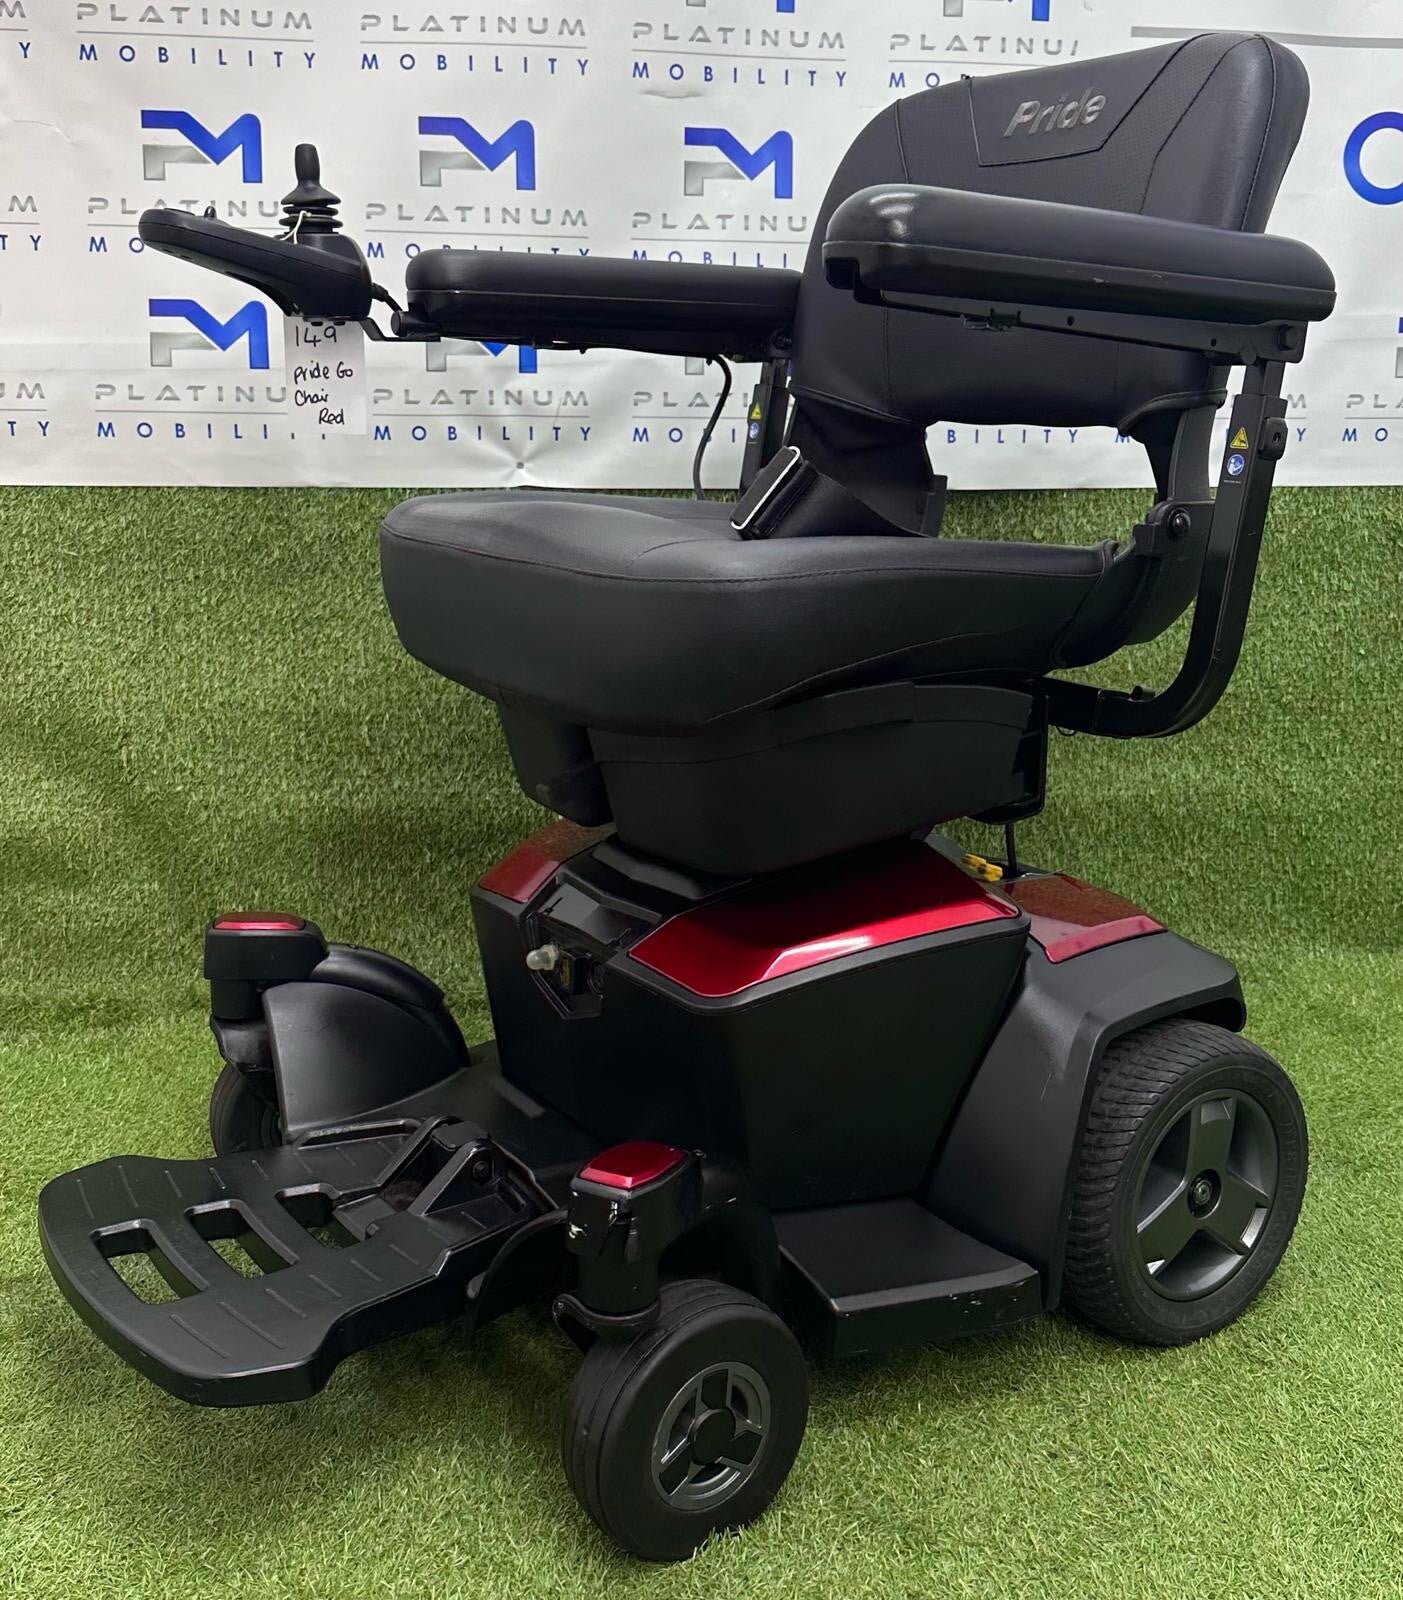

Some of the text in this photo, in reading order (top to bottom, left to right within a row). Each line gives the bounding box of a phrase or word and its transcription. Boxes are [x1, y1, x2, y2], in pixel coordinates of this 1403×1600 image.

[76, 2, 312, 30] PLATINUM
[360, 14, 586, 37] PLATINUM
[632, 21, 845, 49] PLATINUM
[79, 43, 316, 69] MOBILITY
[361, 53, 589, 76] MOBILITY
[632, 61, 847, 87] MOBILITY
[1003, 86, 1106, 138] Pride
[365, 202, 588, 227] PLATINUM
[632, 211, 808, 232] PLATINU
[633, 250, 787, 269] MOBILI
[295, 325, 337, 347] 149
[336, 361, 353, 378] Go
[95, 383, 287, 402] PLATINU
[294, 388, 329, 406] Chair
[373, 388, 589, 407] PLATINUM
[318, 407, 345, 425] Red
[97, 422, 325, 441] MOBILI
[374, 425, 591, 442] MOBILITY
[925, 429, 1078, 444] BILITY
